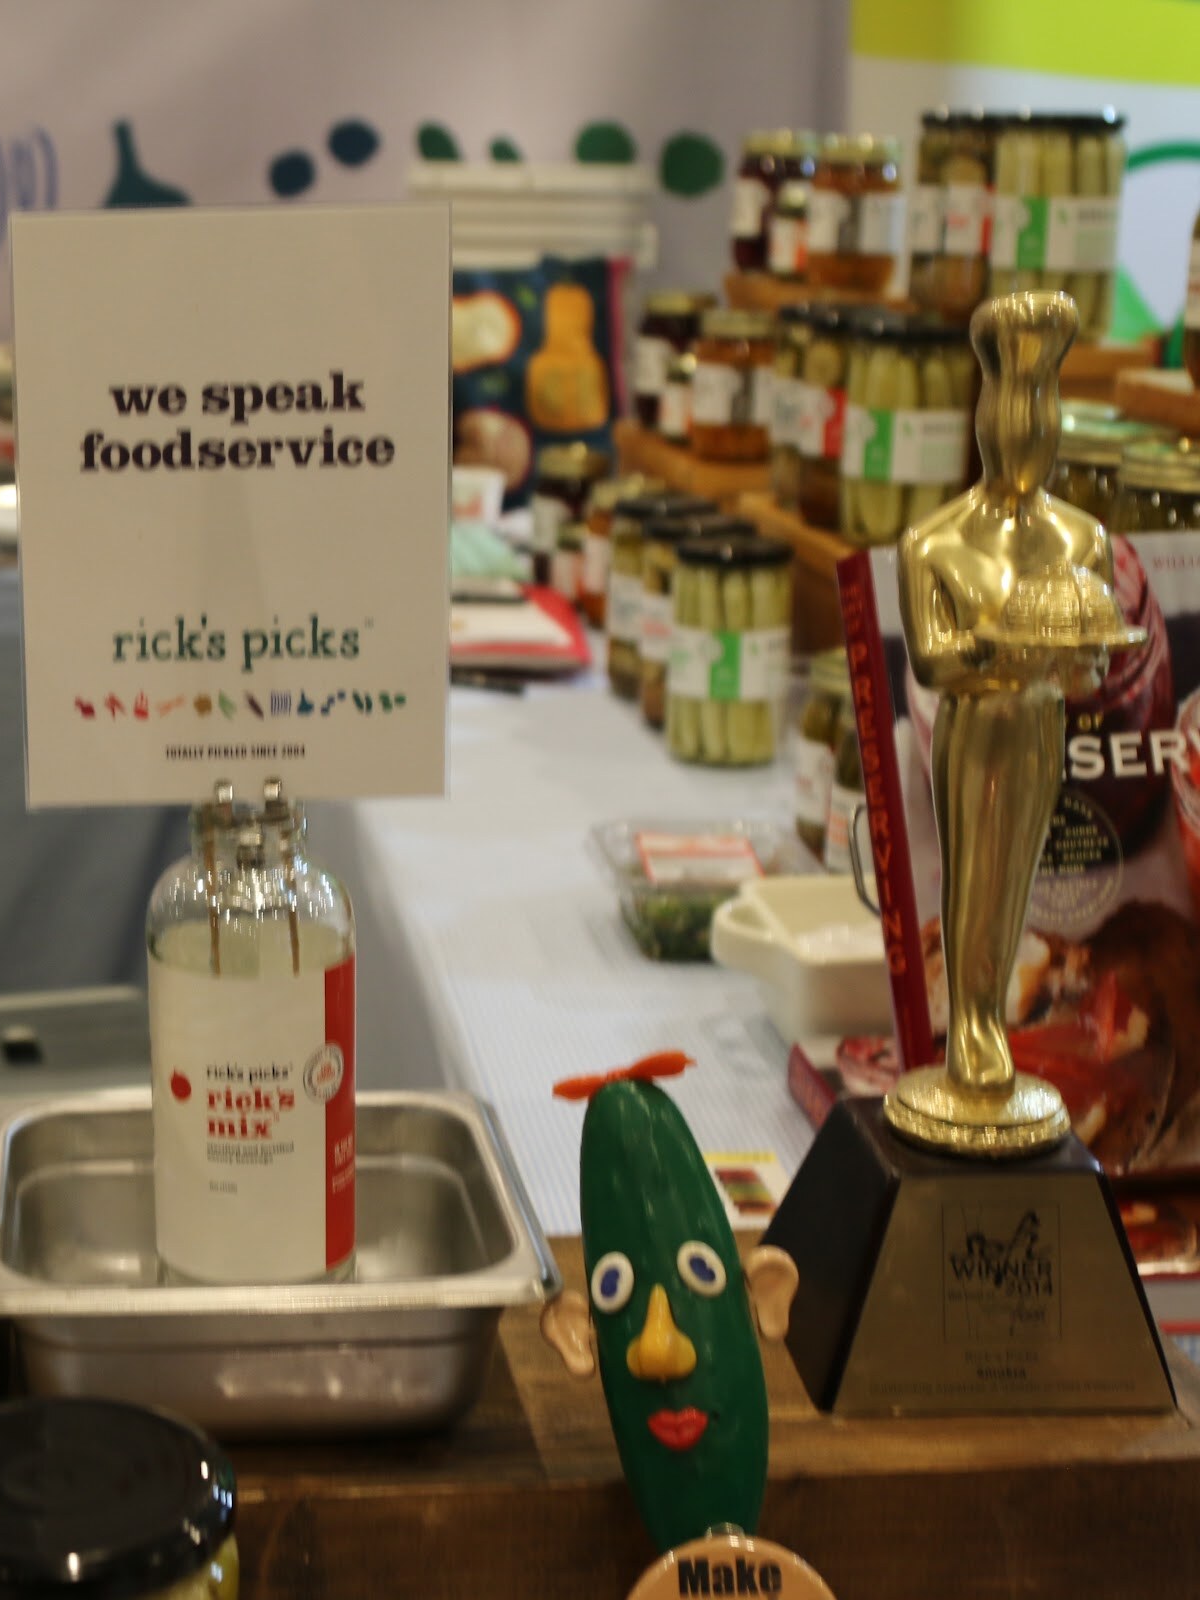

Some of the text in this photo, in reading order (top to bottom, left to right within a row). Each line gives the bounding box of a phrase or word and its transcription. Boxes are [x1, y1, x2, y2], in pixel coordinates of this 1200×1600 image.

[109, 369, 365, 424] we speak
[80, 427, 395, 473] foodservice
[112, 611, 360, 674] rick's picks
[251, 743, 277, 759] SINCE
[282, 742, 305, 758] 2004
[1061, 730, 1200, 782] SER
[206, 1086, 294, 1111] rick's
[206, 1112, 272, 1139] mix
[951, 1254, 1052, 1282] WINNER
[678, 1556, 783, 1598] Make
